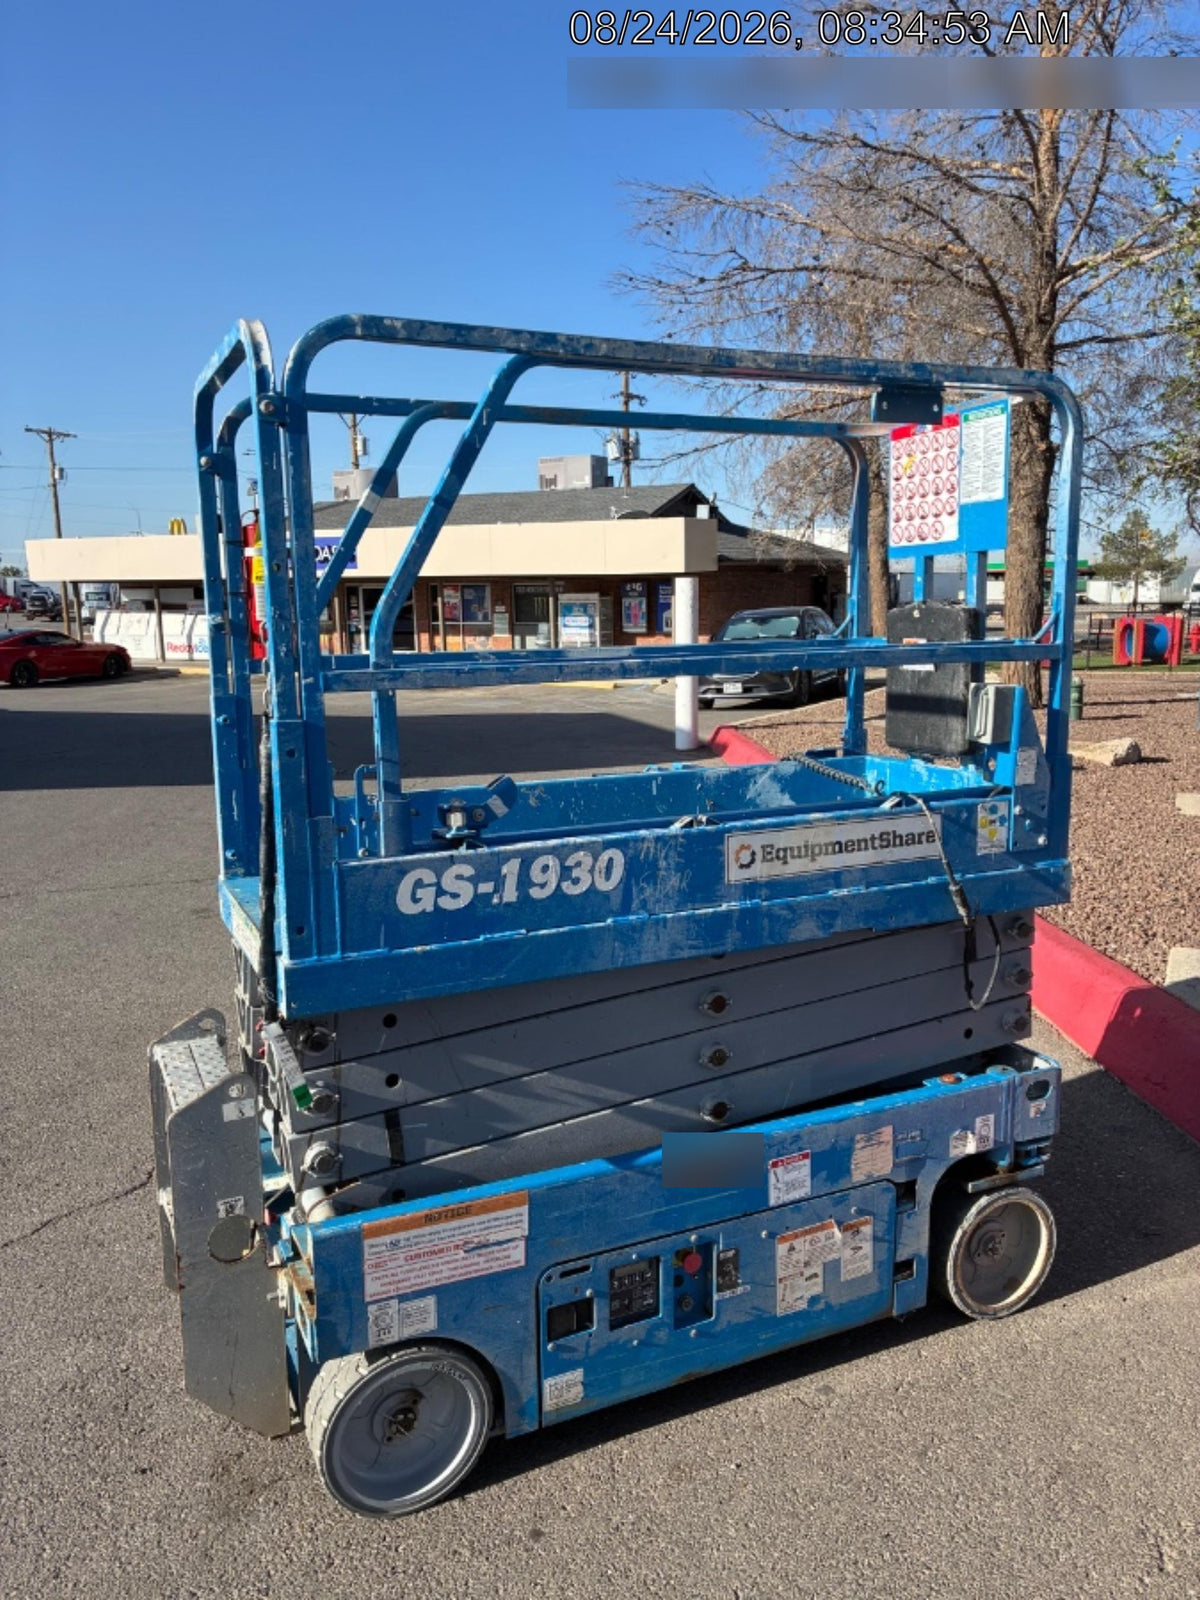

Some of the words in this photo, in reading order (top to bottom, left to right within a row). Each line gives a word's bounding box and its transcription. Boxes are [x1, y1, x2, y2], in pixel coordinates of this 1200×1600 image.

[760, 829, 937, 864] EquipmentShare
[396, 848, 625, 915] GS-1930
[424, 1205, 472, 1223] NOTICE
